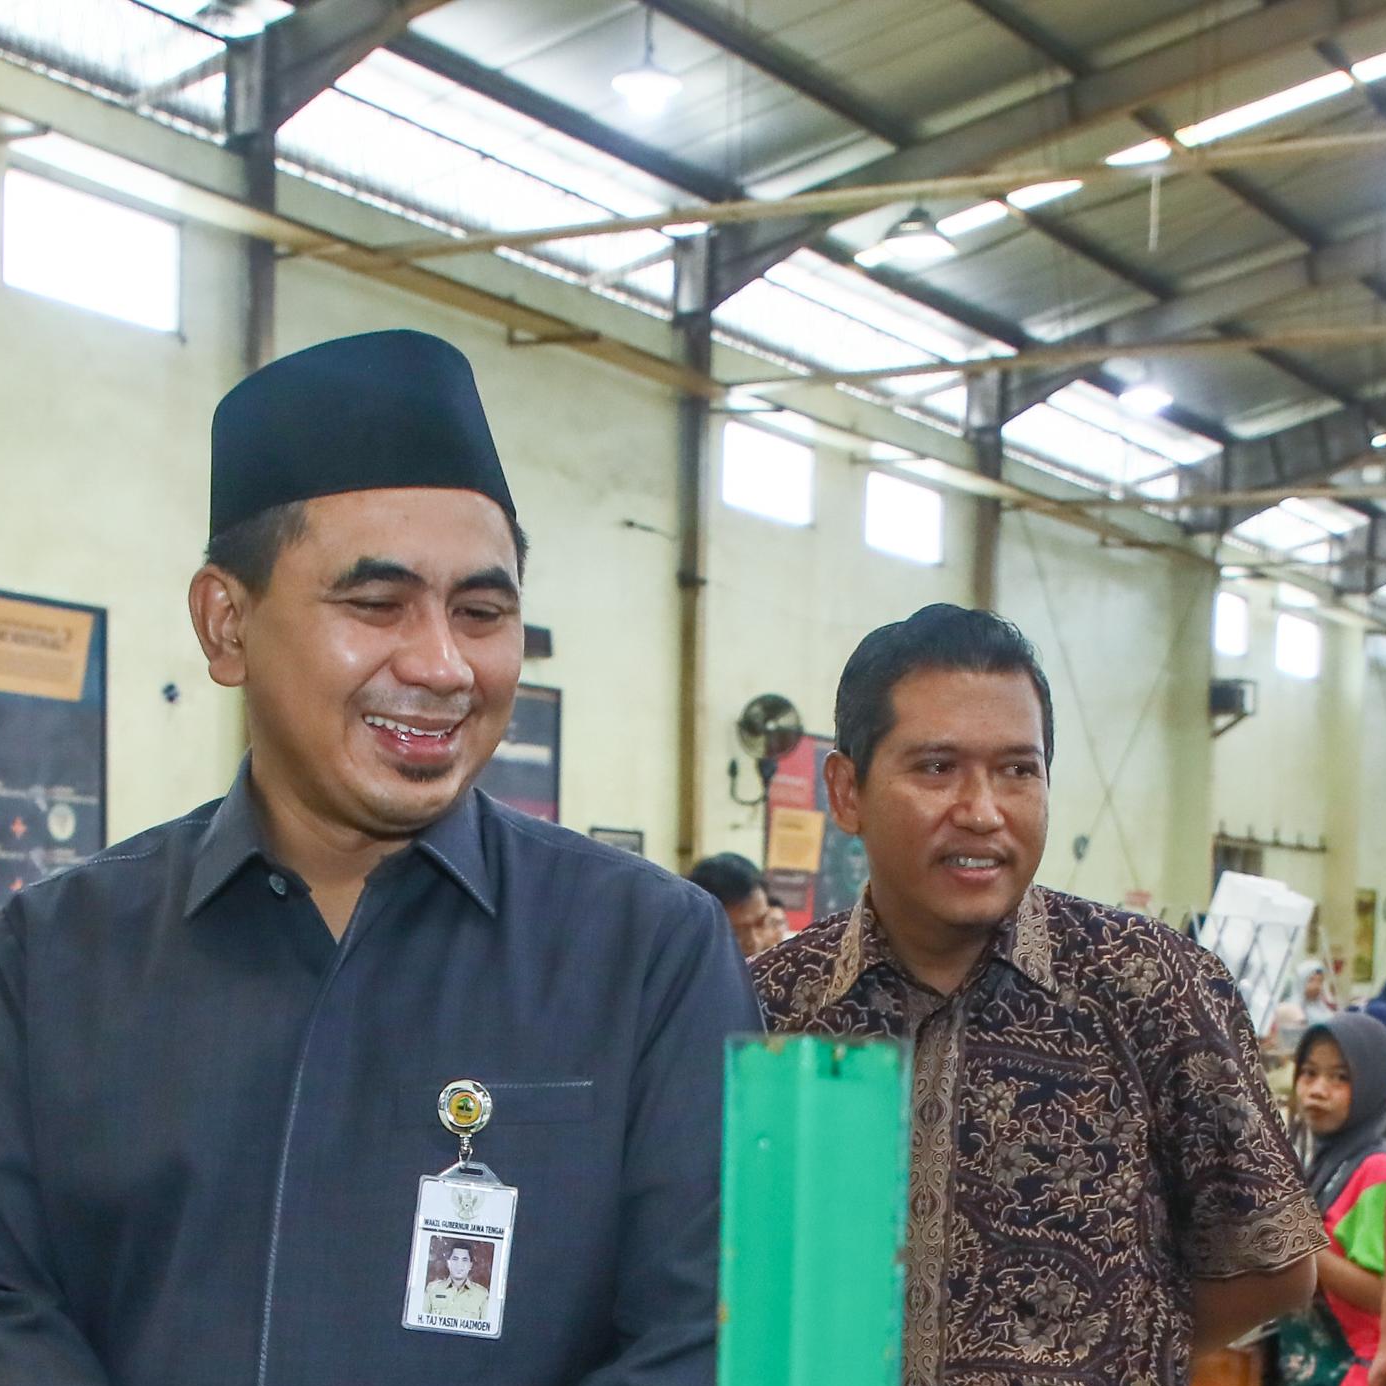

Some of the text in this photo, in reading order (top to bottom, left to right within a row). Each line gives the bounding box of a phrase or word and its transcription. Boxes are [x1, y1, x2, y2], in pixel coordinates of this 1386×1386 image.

[424, 1218, 440, 1227] WAKIL
[441, 1220, 469, 1231] GUBERNUR
[470, 1224, 484, 1233] JAWA
[426, 1315, 437, 1325] TAJ
[439, 1317, 458, 1328] YASIN
